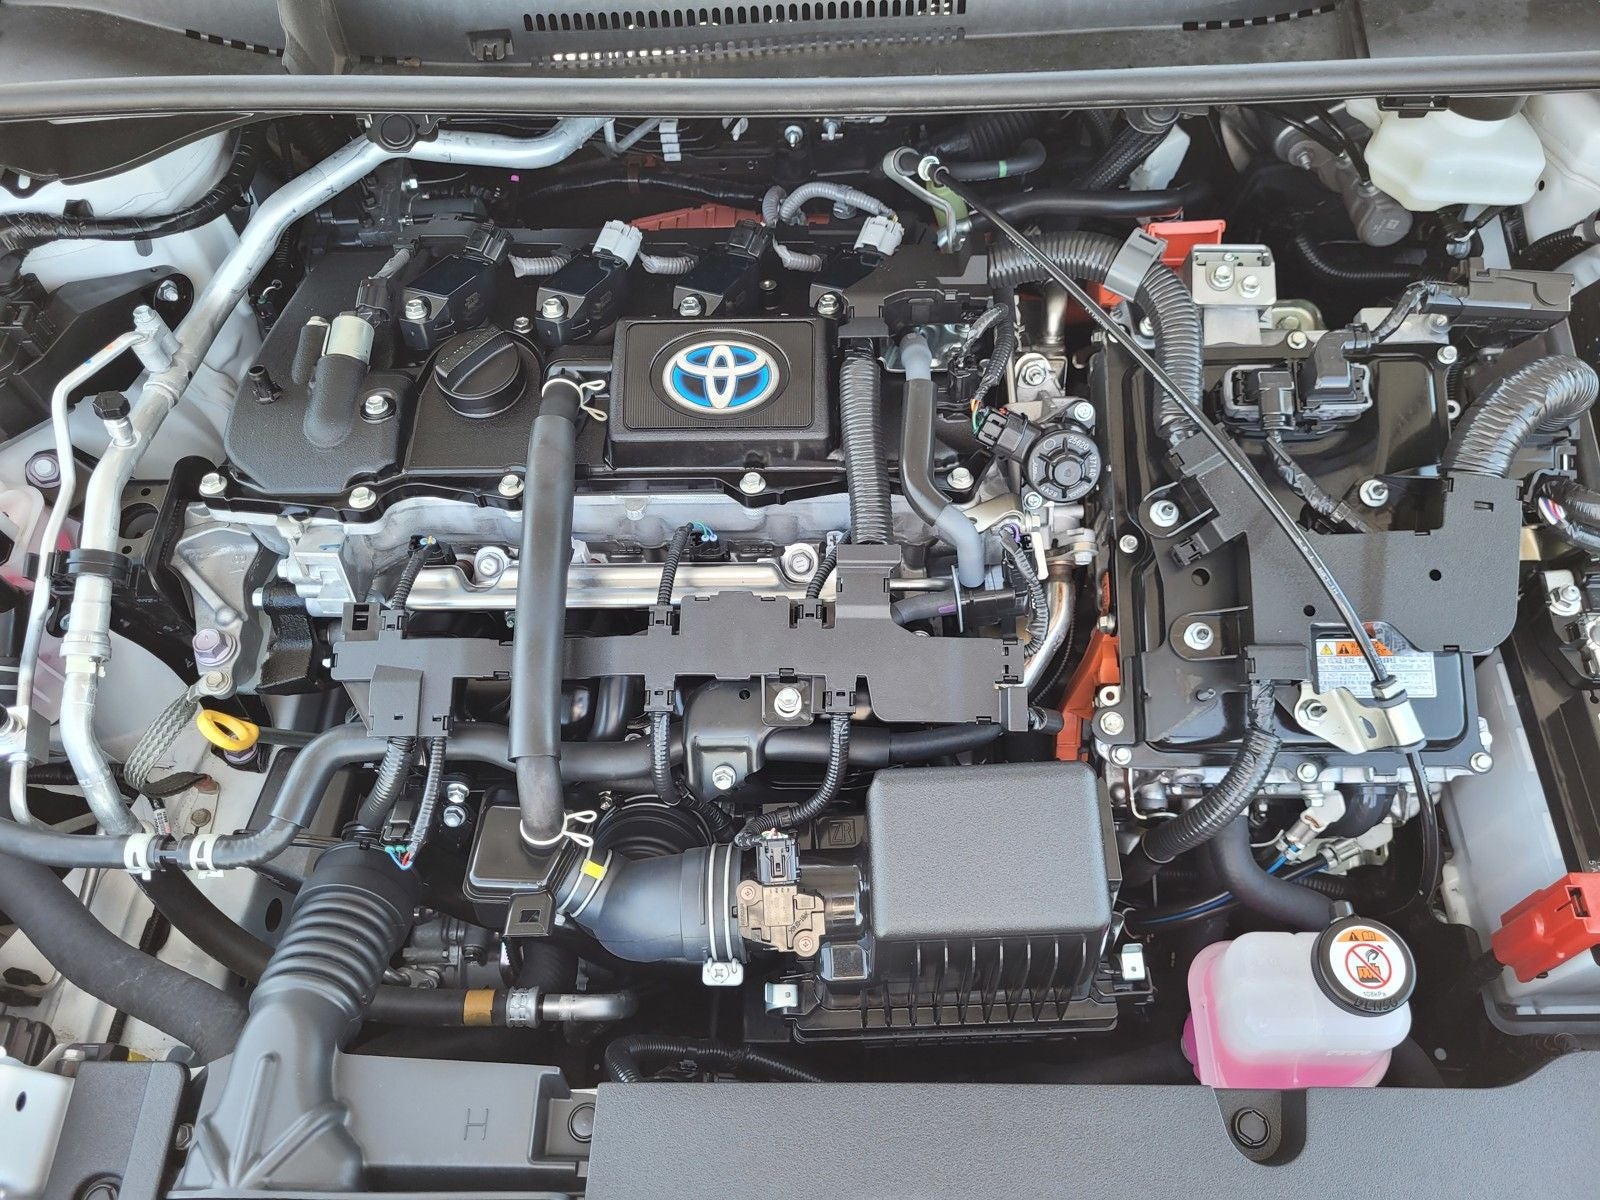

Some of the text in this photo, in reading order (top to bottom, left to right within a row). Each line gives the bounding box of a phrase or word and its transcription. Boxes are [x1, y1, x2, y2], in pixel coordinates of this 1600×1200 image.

[1068, 435, 1097, 477] 25620 37140
[831, 822, 853, 842] ZR
